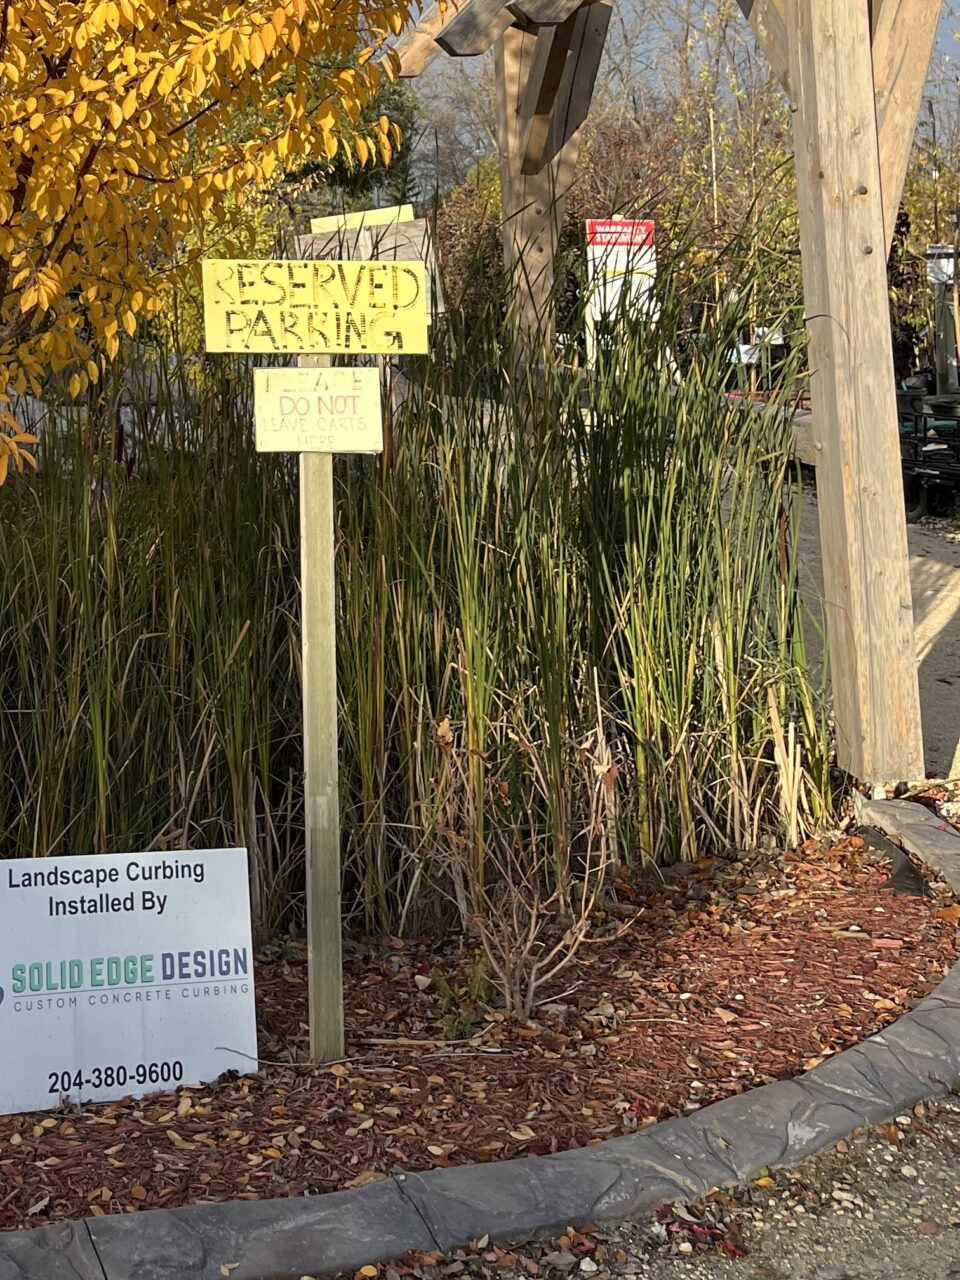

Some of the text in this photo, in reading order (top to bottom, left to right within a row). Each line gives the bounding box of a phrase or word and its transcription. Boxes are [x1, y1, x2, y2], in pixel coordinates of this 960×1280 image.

[211, 261, 420, 311] RESERVED
[225, 310, 403, 350] PARKING
[279, 394, 361, 416] DO NOT
[262, 416, 367, 432] LEAVE CARTS
[297, 435, 336, 450] HERE
[8, 860, 205, 888] Landscape Curbing
[49, 891, 168, 916] Installed By
[12, 947, 248, 993] SOLID EDGE DESIGN
[13, 983, 249, 1012] CUSTOM CONCRETE CURBING
[48, 1061, 183, 1093] 204-380-9600
